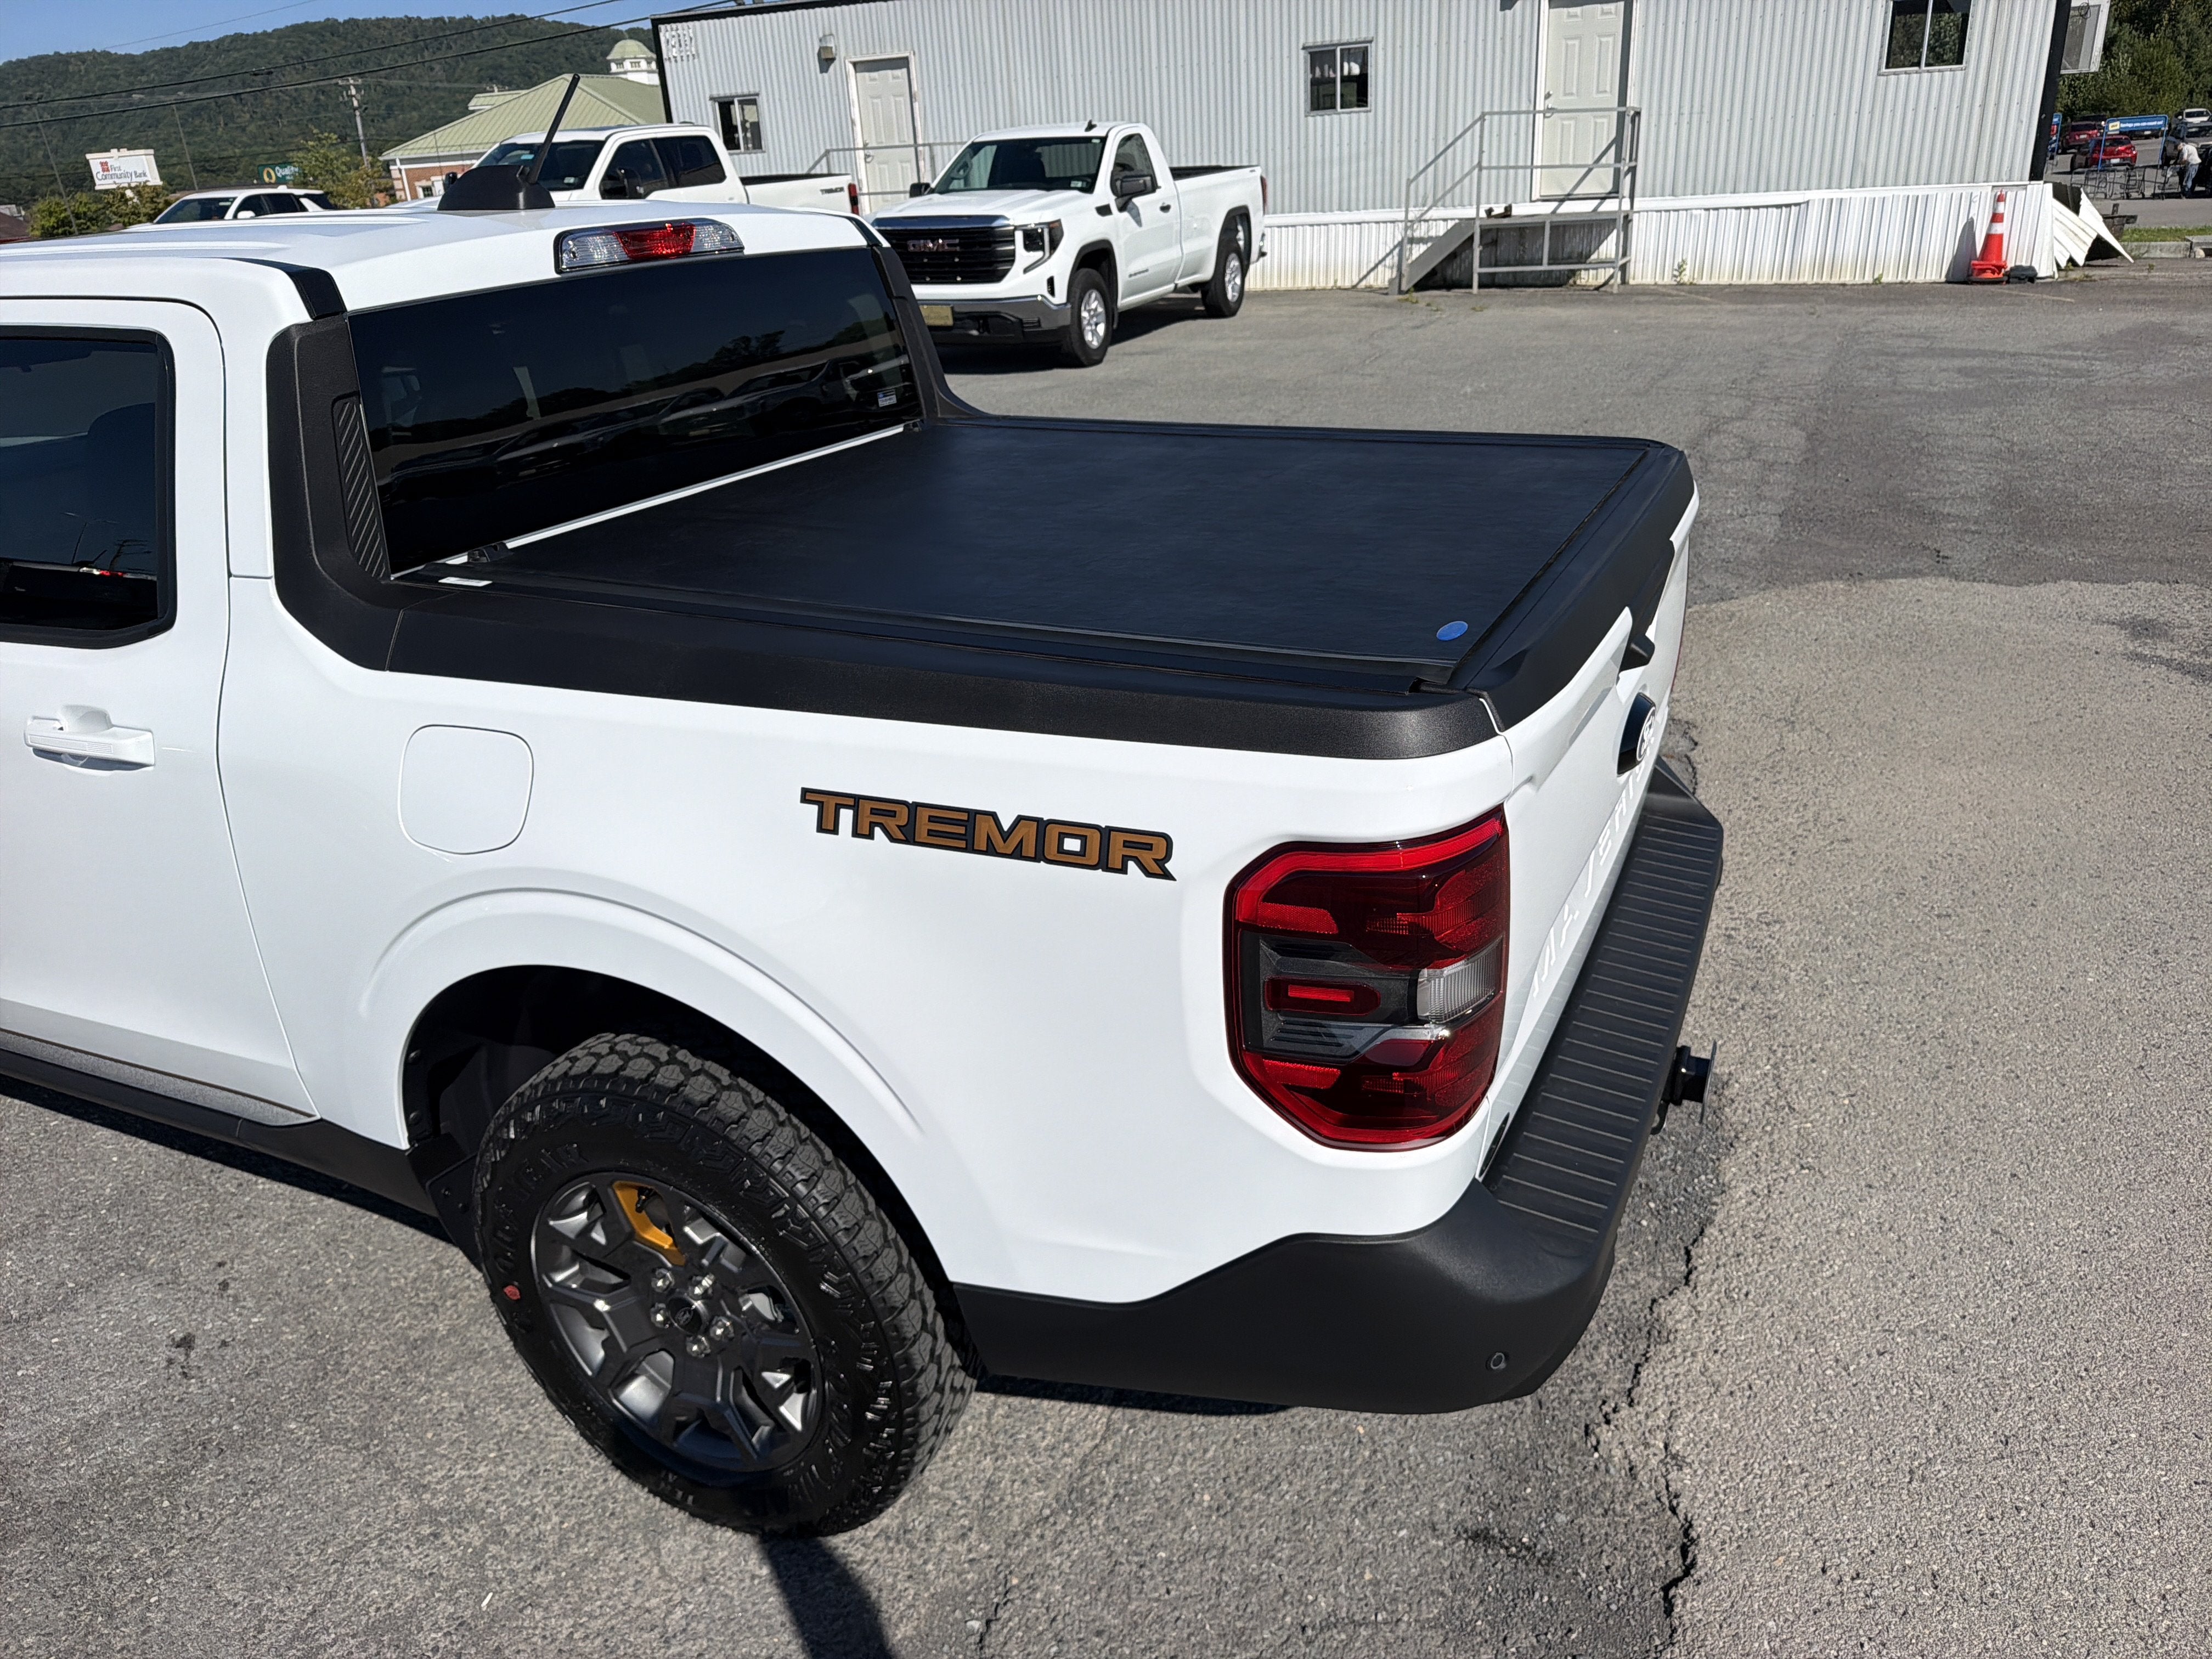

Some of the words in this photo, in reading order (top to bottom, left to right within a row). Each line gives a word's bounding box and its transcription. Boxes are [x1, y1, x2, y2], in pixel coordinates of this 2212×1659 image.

[95, 170, 133, 182] Community
[133, 170, 148, 178] Bank
[907, 238, 960, 252] GMC
[800, 787, 1177, 882] TREMOR
